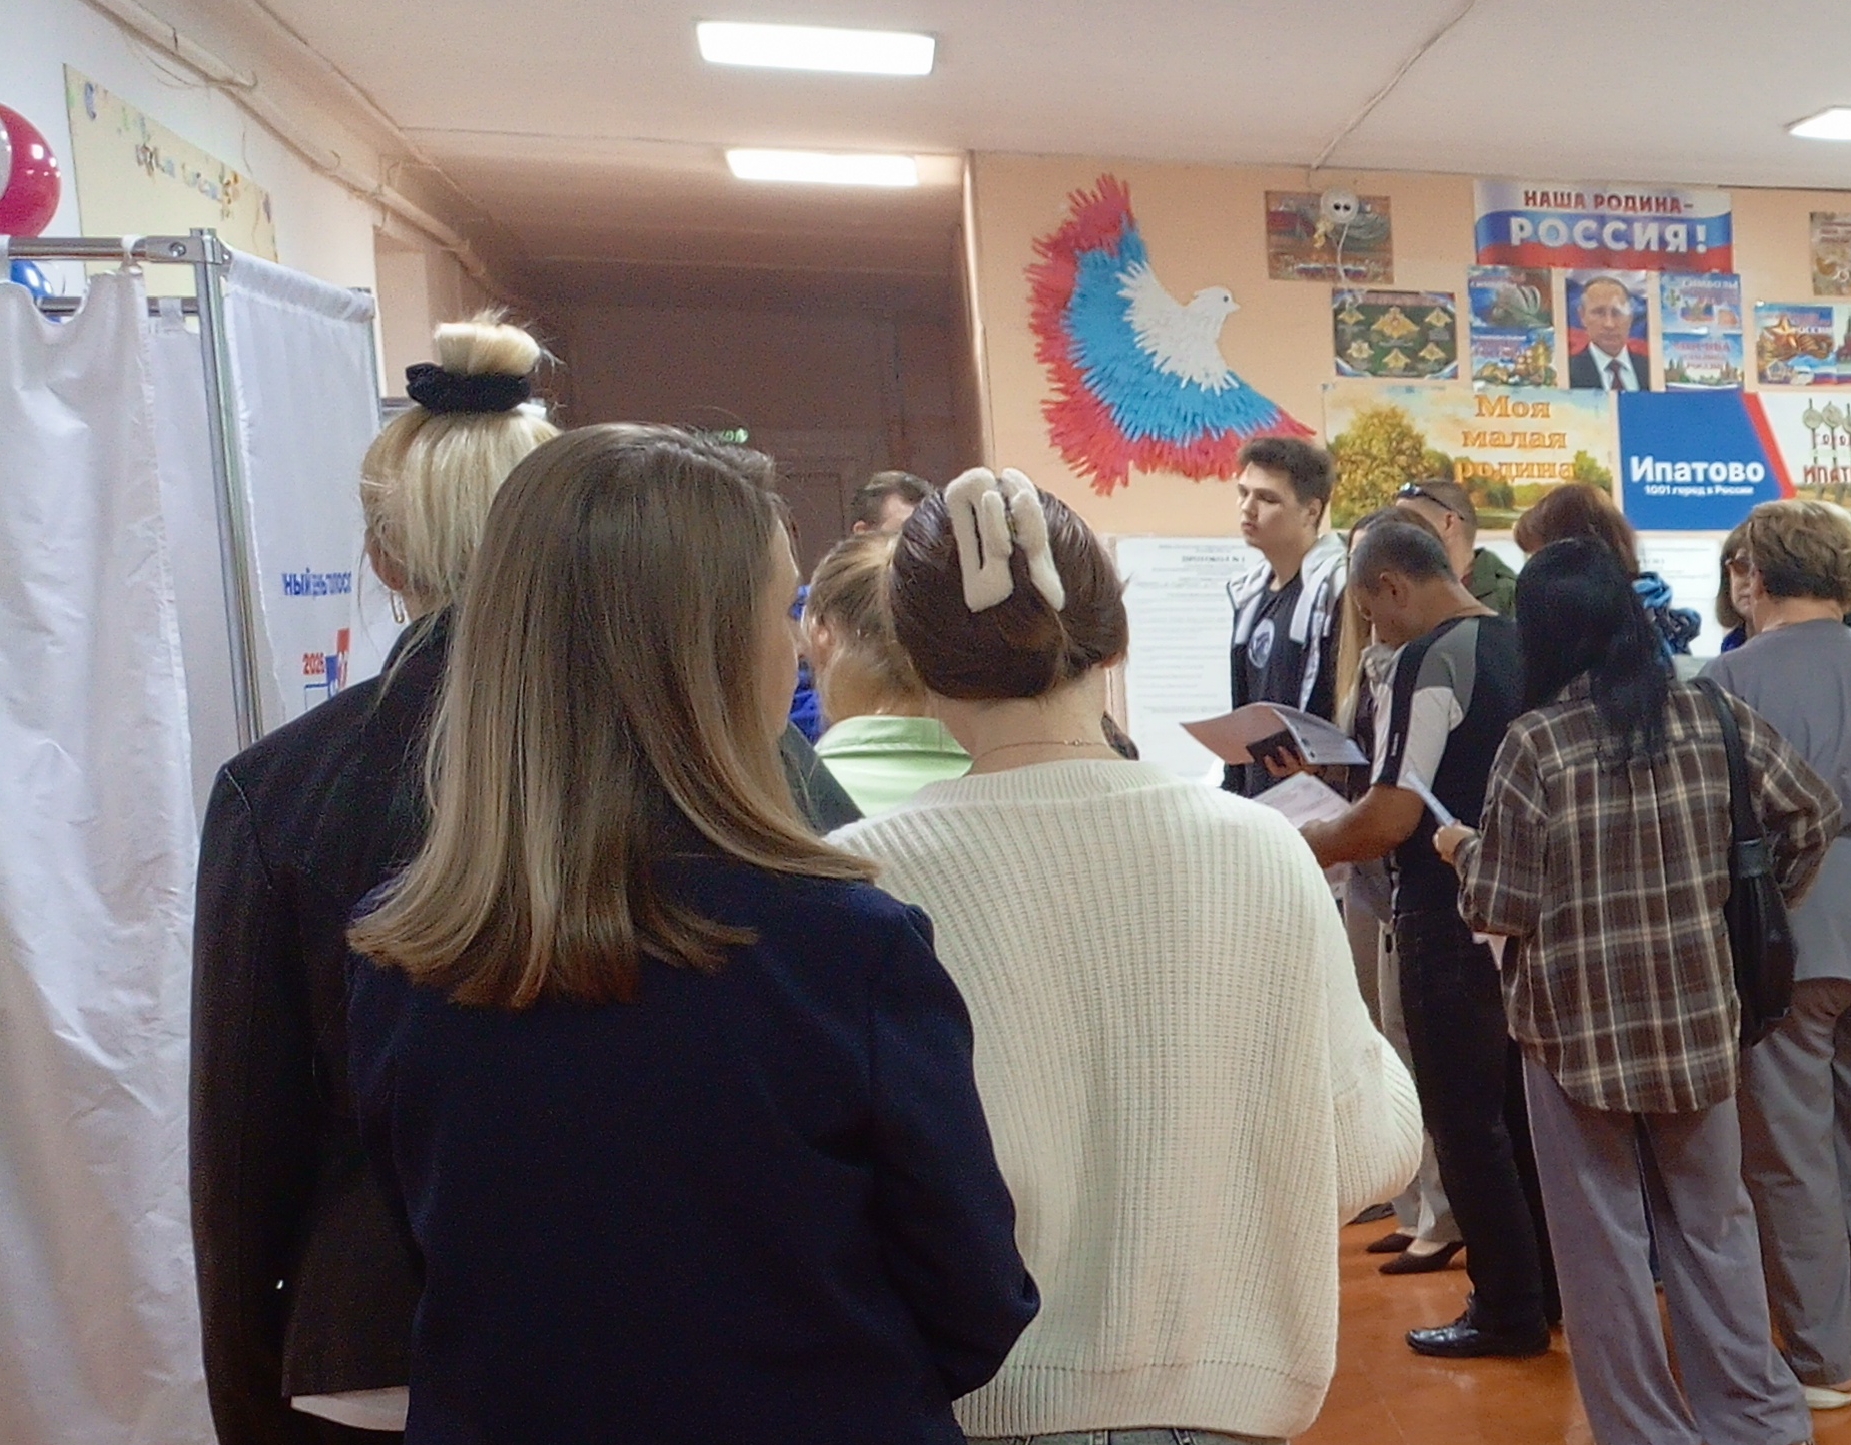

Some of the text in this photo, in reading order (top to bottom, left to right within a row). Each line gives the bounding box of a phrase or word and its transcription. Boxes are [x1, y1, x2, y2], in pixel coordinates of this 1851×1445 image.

[1523, 189, 1586, 210] НАША
[1510, 216, 1707, 254] РОССИЯ!
[1474, 394, 1551, 418] Моя
[1462, 429, 1567, 449] малая
[1454, 460, 1577, 482] родина
[1630, 456, 1766, 483] Ипатово
